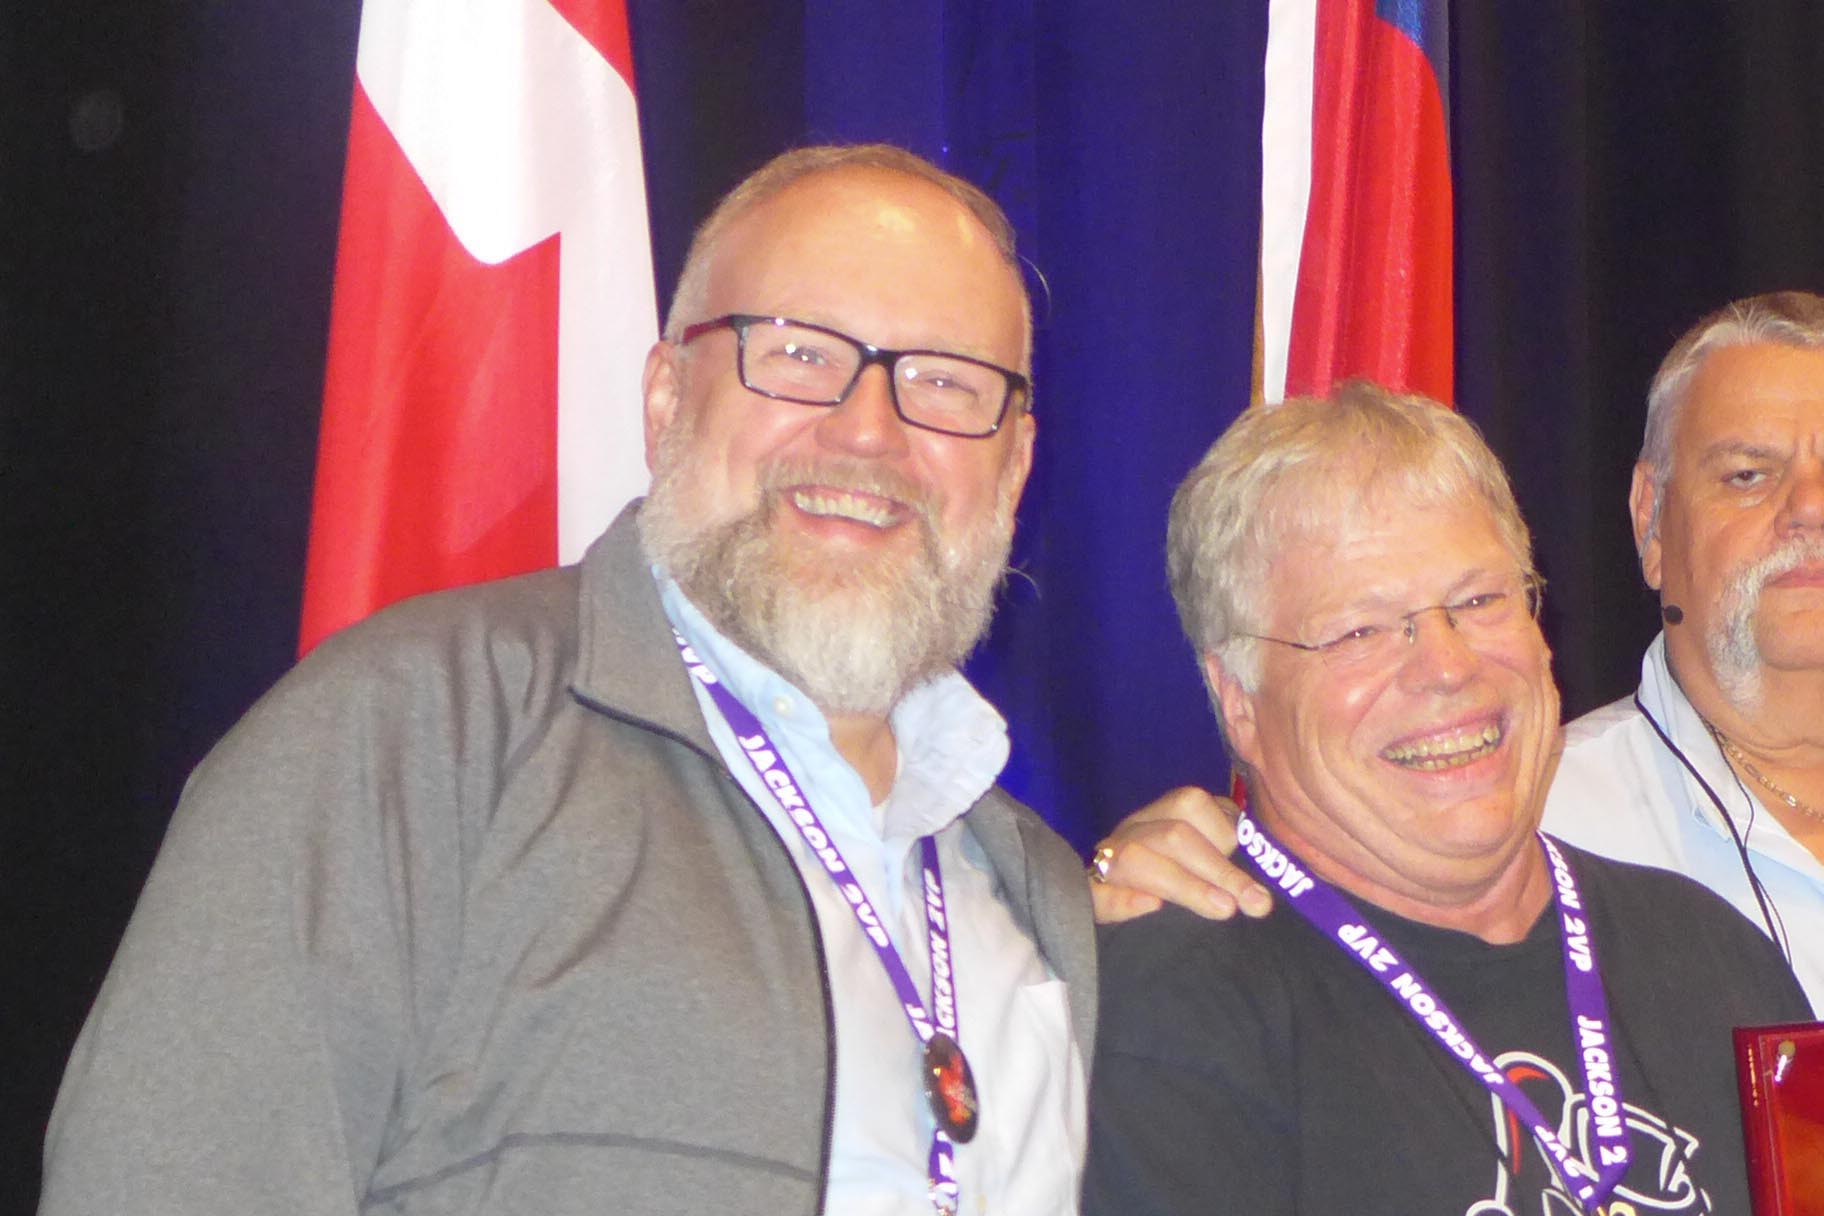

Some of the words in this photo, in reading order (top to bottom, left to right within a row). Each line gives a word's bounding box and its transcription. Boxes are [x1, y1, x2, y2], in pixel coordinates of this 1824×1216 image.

[738, 734, 846, 873] JACKSON
[1237, 811, 1315, 897] JACKSO
[934, 929, 957, 1038] CKSON
[1337, 924, 1400, 972] 2VP
[1564, 912, 1593, 972] 2VP
[1391, 973, 1505, 1084] JACKSON
[1577, 1015, 1622, 1137] JACKSON
